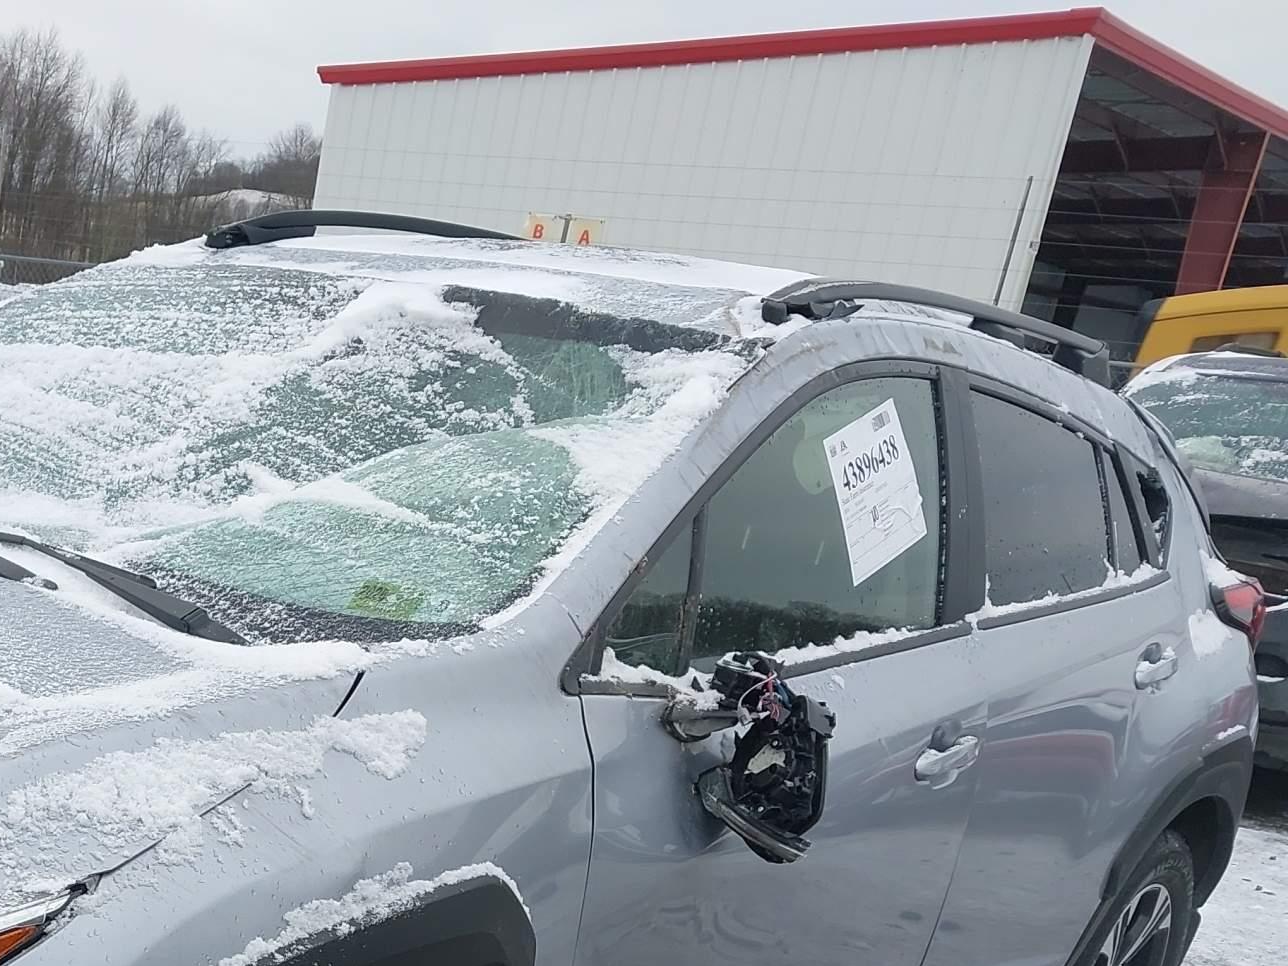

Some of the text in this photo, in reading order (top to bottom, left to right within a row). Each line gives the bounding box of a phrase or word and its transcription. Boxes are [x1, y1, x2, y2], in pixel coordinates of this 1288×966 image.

[532, 223, 545, 239] B
[578, 229, 590, 246] A
[842, 434, 900, 492] 43896438
